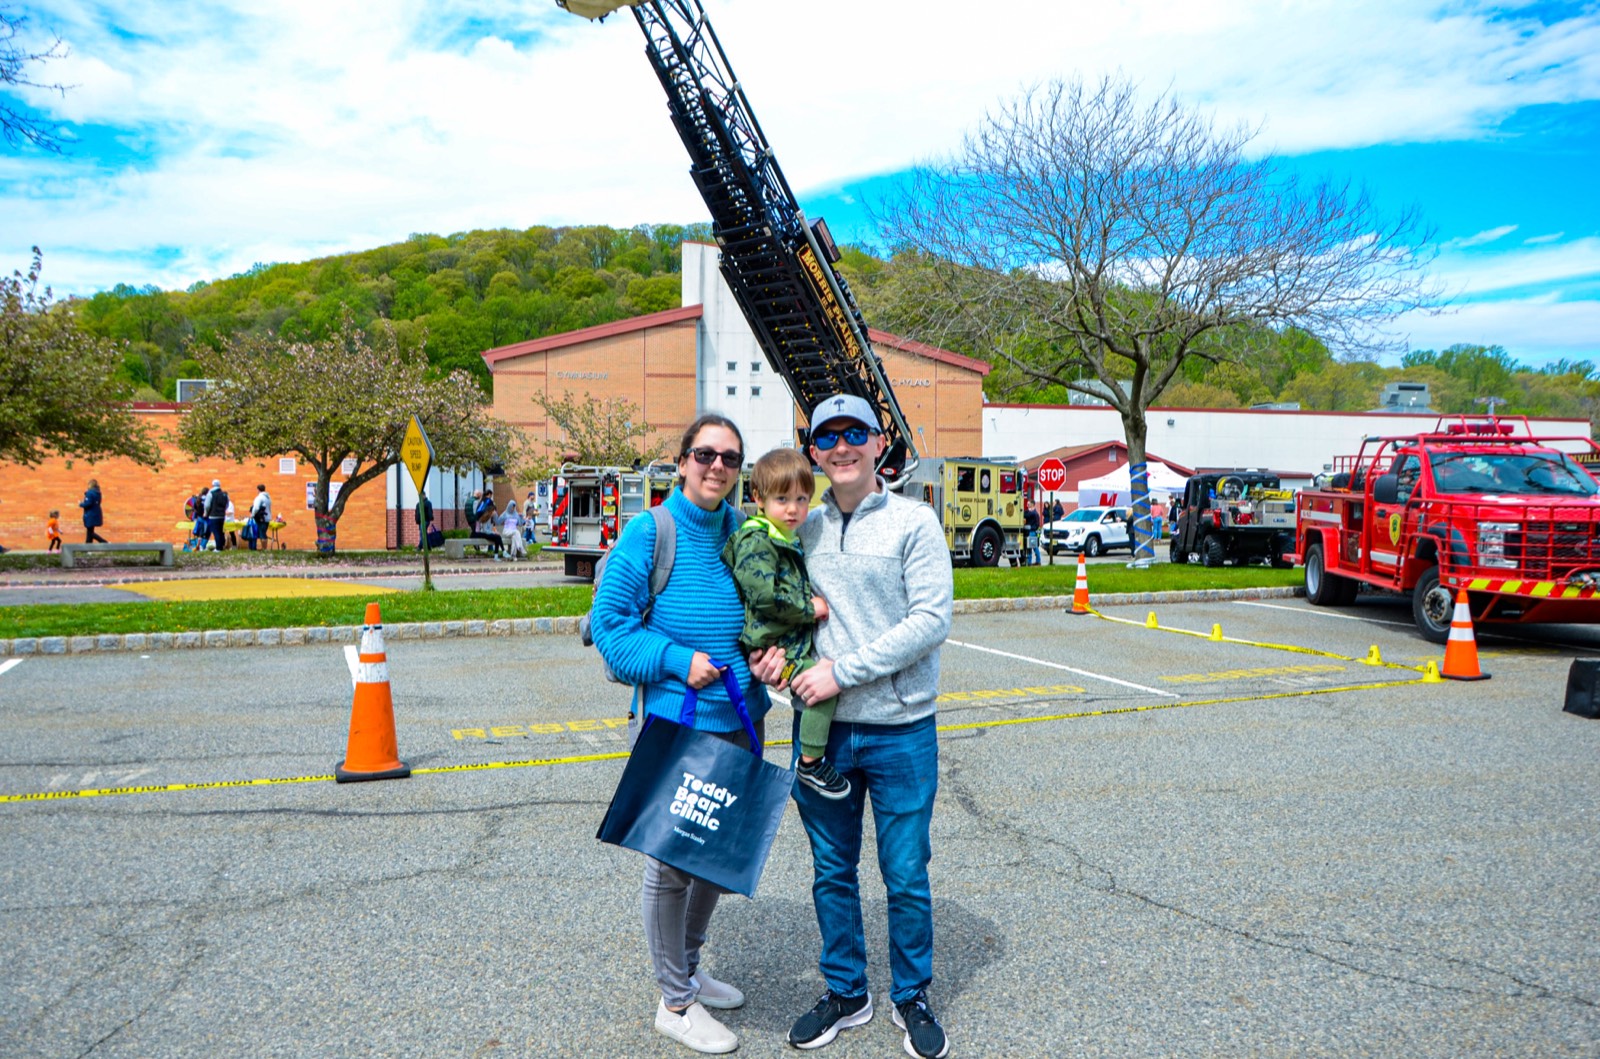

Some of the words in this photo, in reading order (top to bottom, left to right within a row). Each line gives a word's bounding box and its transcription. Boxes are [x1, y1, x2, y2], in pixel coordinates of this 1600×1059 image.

[801, 247, 835, 303] MORRIS
[832, 305, 859, 358] PLAINS
[556, 371, 608, 380] GYMNASIUM
[898, 378, 931, 388] HYLAND
[407, 436, 422, 446] CAUTION
[410, 449, 422, 459] SPEED
[411, 462, 422, 472] BUMP
[1040, 468, 1064, 482] STOP
[452, 717, 629, 741] RESER
[683, 772, 738, 808] Teddy
[674, 785, 721, 813] Bear
[669, 800, 720, 831] Clinic
